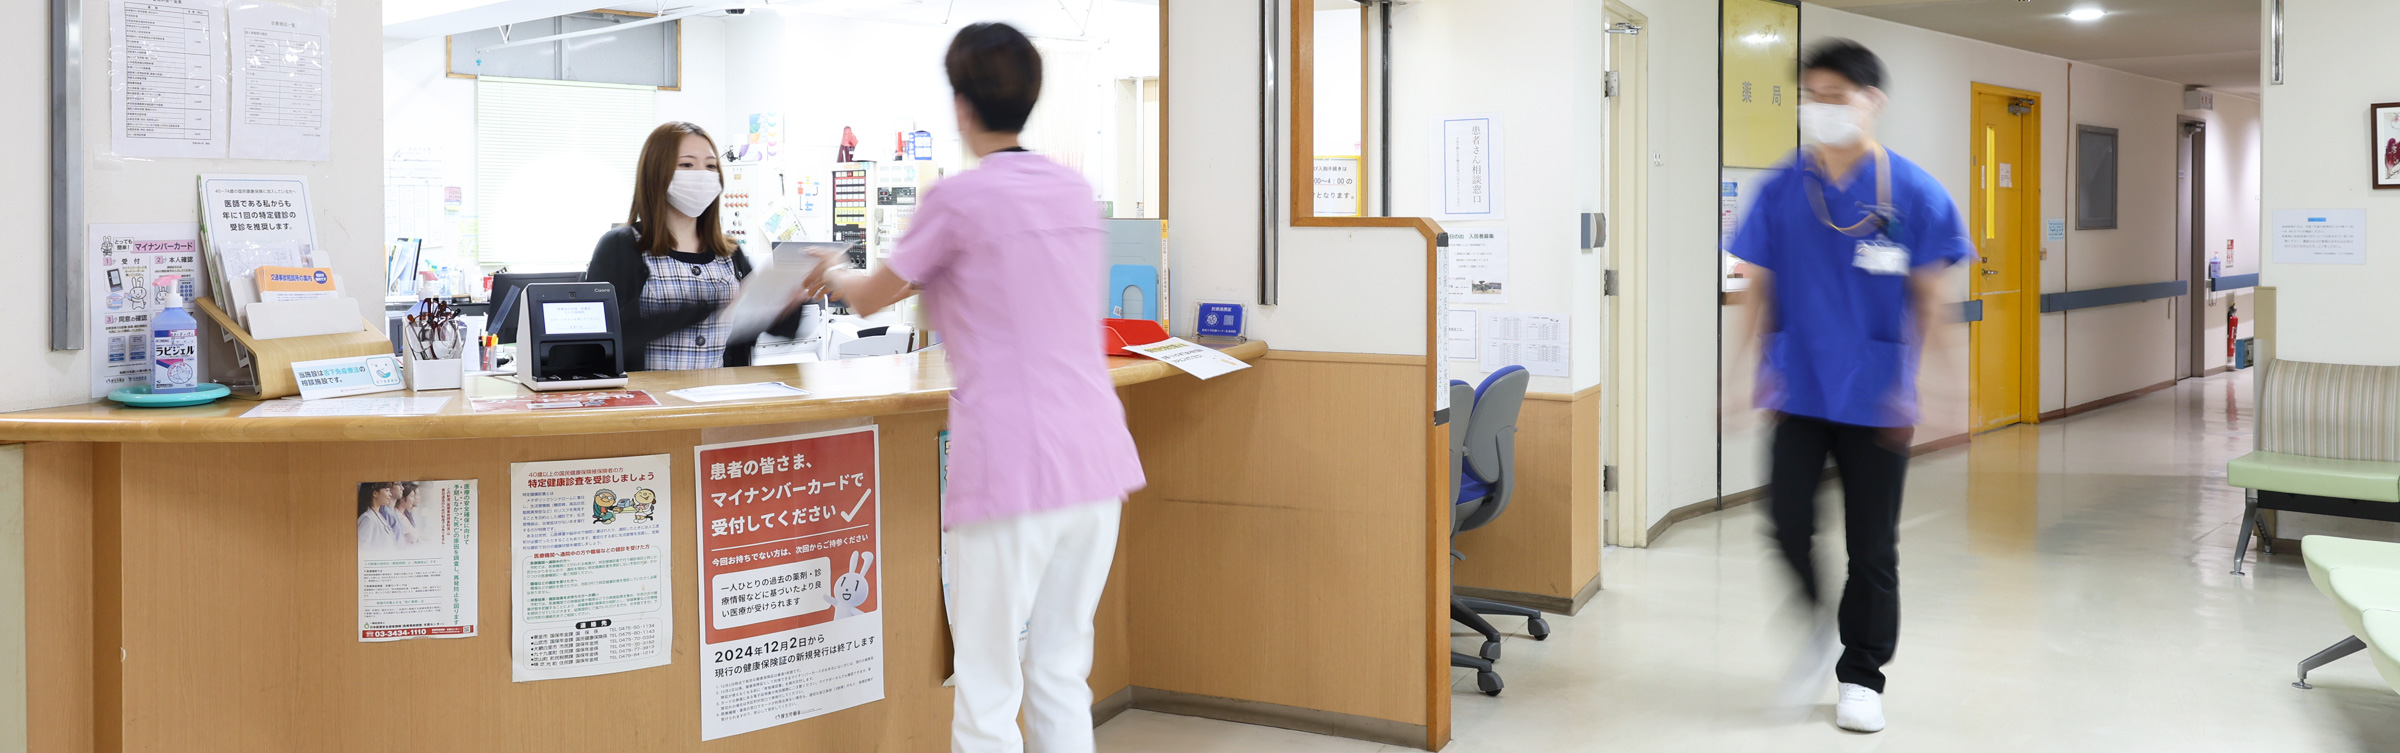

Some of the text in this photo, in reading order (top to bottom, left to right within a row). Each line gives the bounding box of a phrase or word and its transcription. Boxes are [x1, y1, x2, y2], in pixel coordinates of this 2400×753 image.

[1742, 81, 1782, 107] 薬局
[1472, 125, 1482, 203] 患者さん相談窓口
[224, 199, 292, 208] 医師である私からも
[1313, 192, 1355, 200] となります。
[222, 211, 297, 220] 年に1回の特定健診の
[229, 222, 293, 232] 受診を推奨します。
[134, 241, 193, 251] マイナンバーカード
[118, 315, 148, 323] 同意の確認
[155, 346, 195, 357] ラビジェル
[298, 365, 366, 379] 当施設は舌下免疫療法の
[301, 376, 343, 387] 相談施設です。
[528, 467, 624, 478] 40歳以上の国民健康保険被保険者の方
[710, 453, 812, 481] 患者の皆さま、
[527, 471, 655, 489] 特定健康診査を受診しましょう
[711, 472, 864, 508] マイナンバーカードで
[463, 483, 471, 545] 医療の安全確保に向けて
[711, 505, 837, 537] 受付してください
[712, 534, 869, 567] 今回お持ちでない方は、次回からご持参ください
[720, 568, 822, 592] 一人ひとりの過去の薬剤・診
[721, 581, 822, 606] 療情報などに基づいたより良
[721, 597, 801, 618] い医療が受けられます
[374, 629, 427, 637] 03-3434-1110
[619, 623, 655, 632] 0475-50-1134
[714, 634, 825, 663] 2024年12月2日から
[714, 635, 876, 679] 現行の健康保険証の新規発行は終了します
